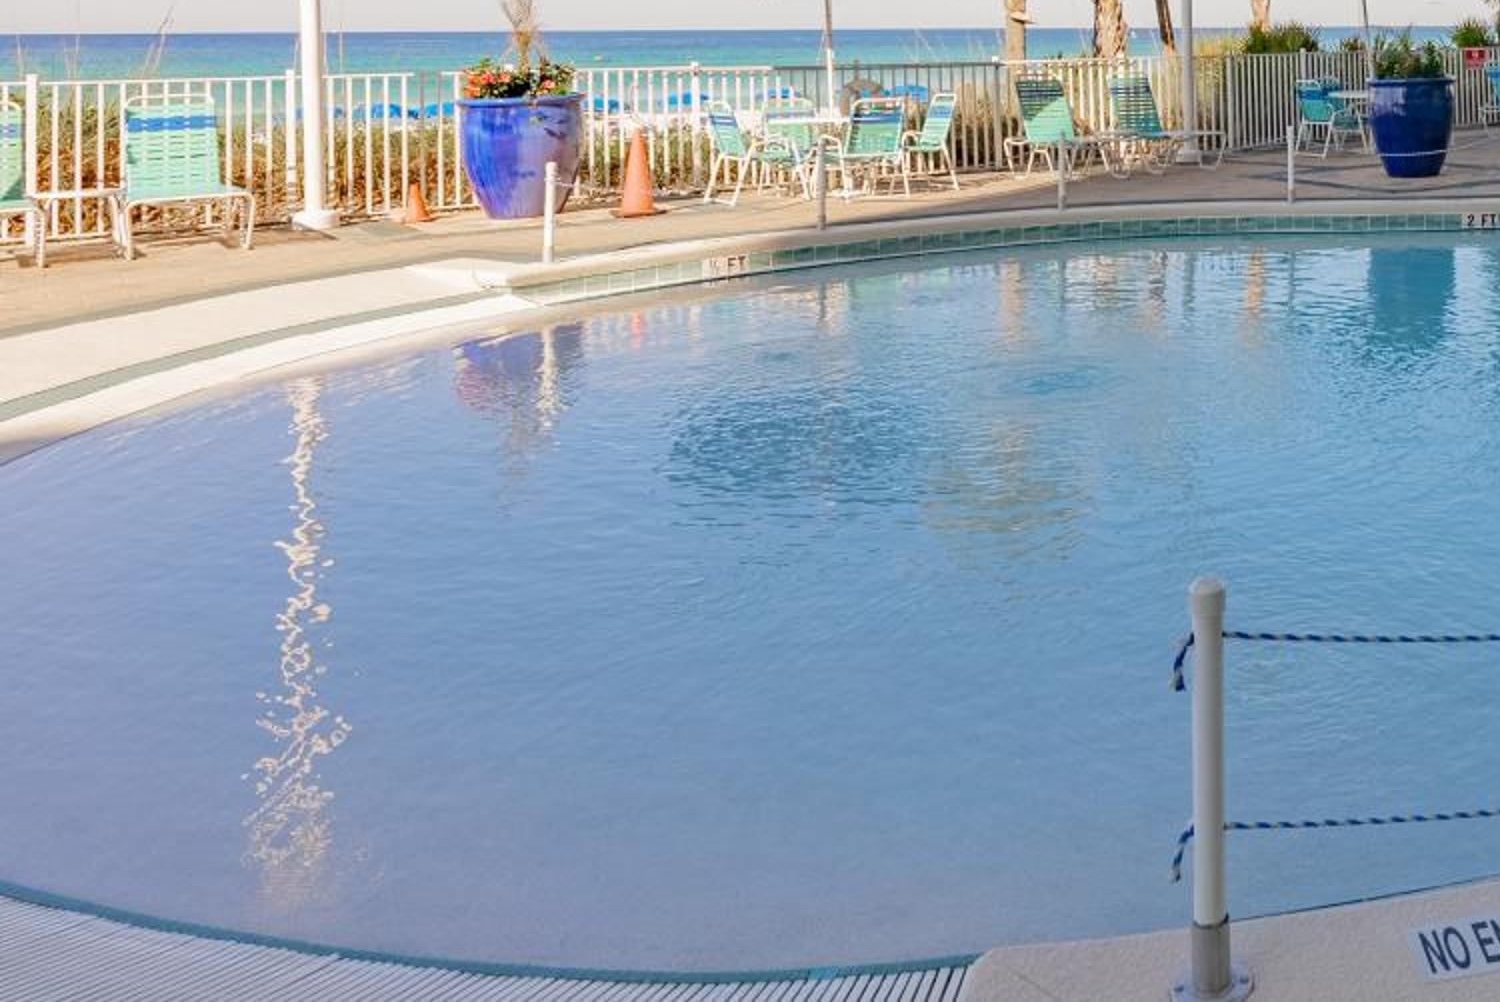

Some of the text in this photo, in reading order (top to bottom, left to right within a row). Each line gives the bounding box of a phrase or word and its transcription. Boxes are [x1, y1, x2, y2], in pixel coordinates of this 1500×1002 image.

[1467, 213, 1496, 227] 2 FT
[1417, 926, 1471, 974] NO
